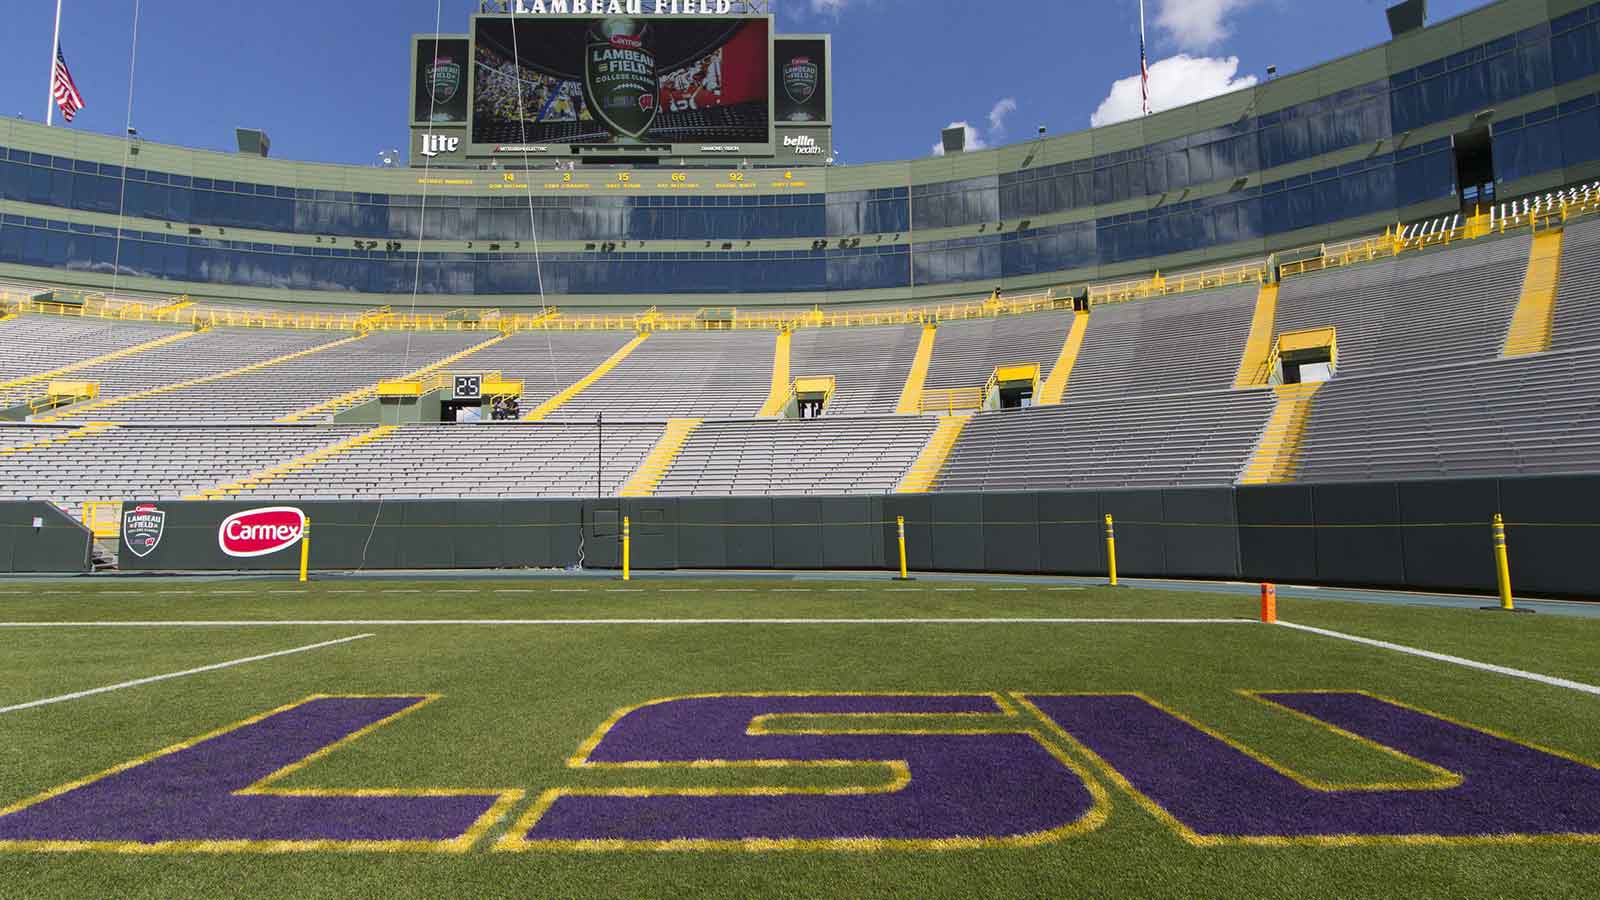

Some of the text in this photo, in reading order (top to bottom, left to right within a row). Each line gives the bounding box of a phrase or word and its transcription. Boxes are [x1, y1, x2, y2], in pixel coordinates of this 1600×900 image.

[515, 0, 731, 14] LAMBEAU FIELD
[593, 49, 654, 66] LAMBEAU
[609, 60, 646, 73] FIELD
[420, 134, 459, 156] Lite
[563, 172, 572, 182] 3
[617, 172, 630, 181] 15
[671, 172, 686, 181] 66
[729, 172, 744, 181] 92
[784, 171, 792, 179] 4
[456, 378, 478, 395] 25
[127, 515, 161, 523] LAMBEAU
[134, 521, 154, 529] FIELD
[226, 520, 300, 541] Carmex
[0, 691, 1600, 852] LSU
